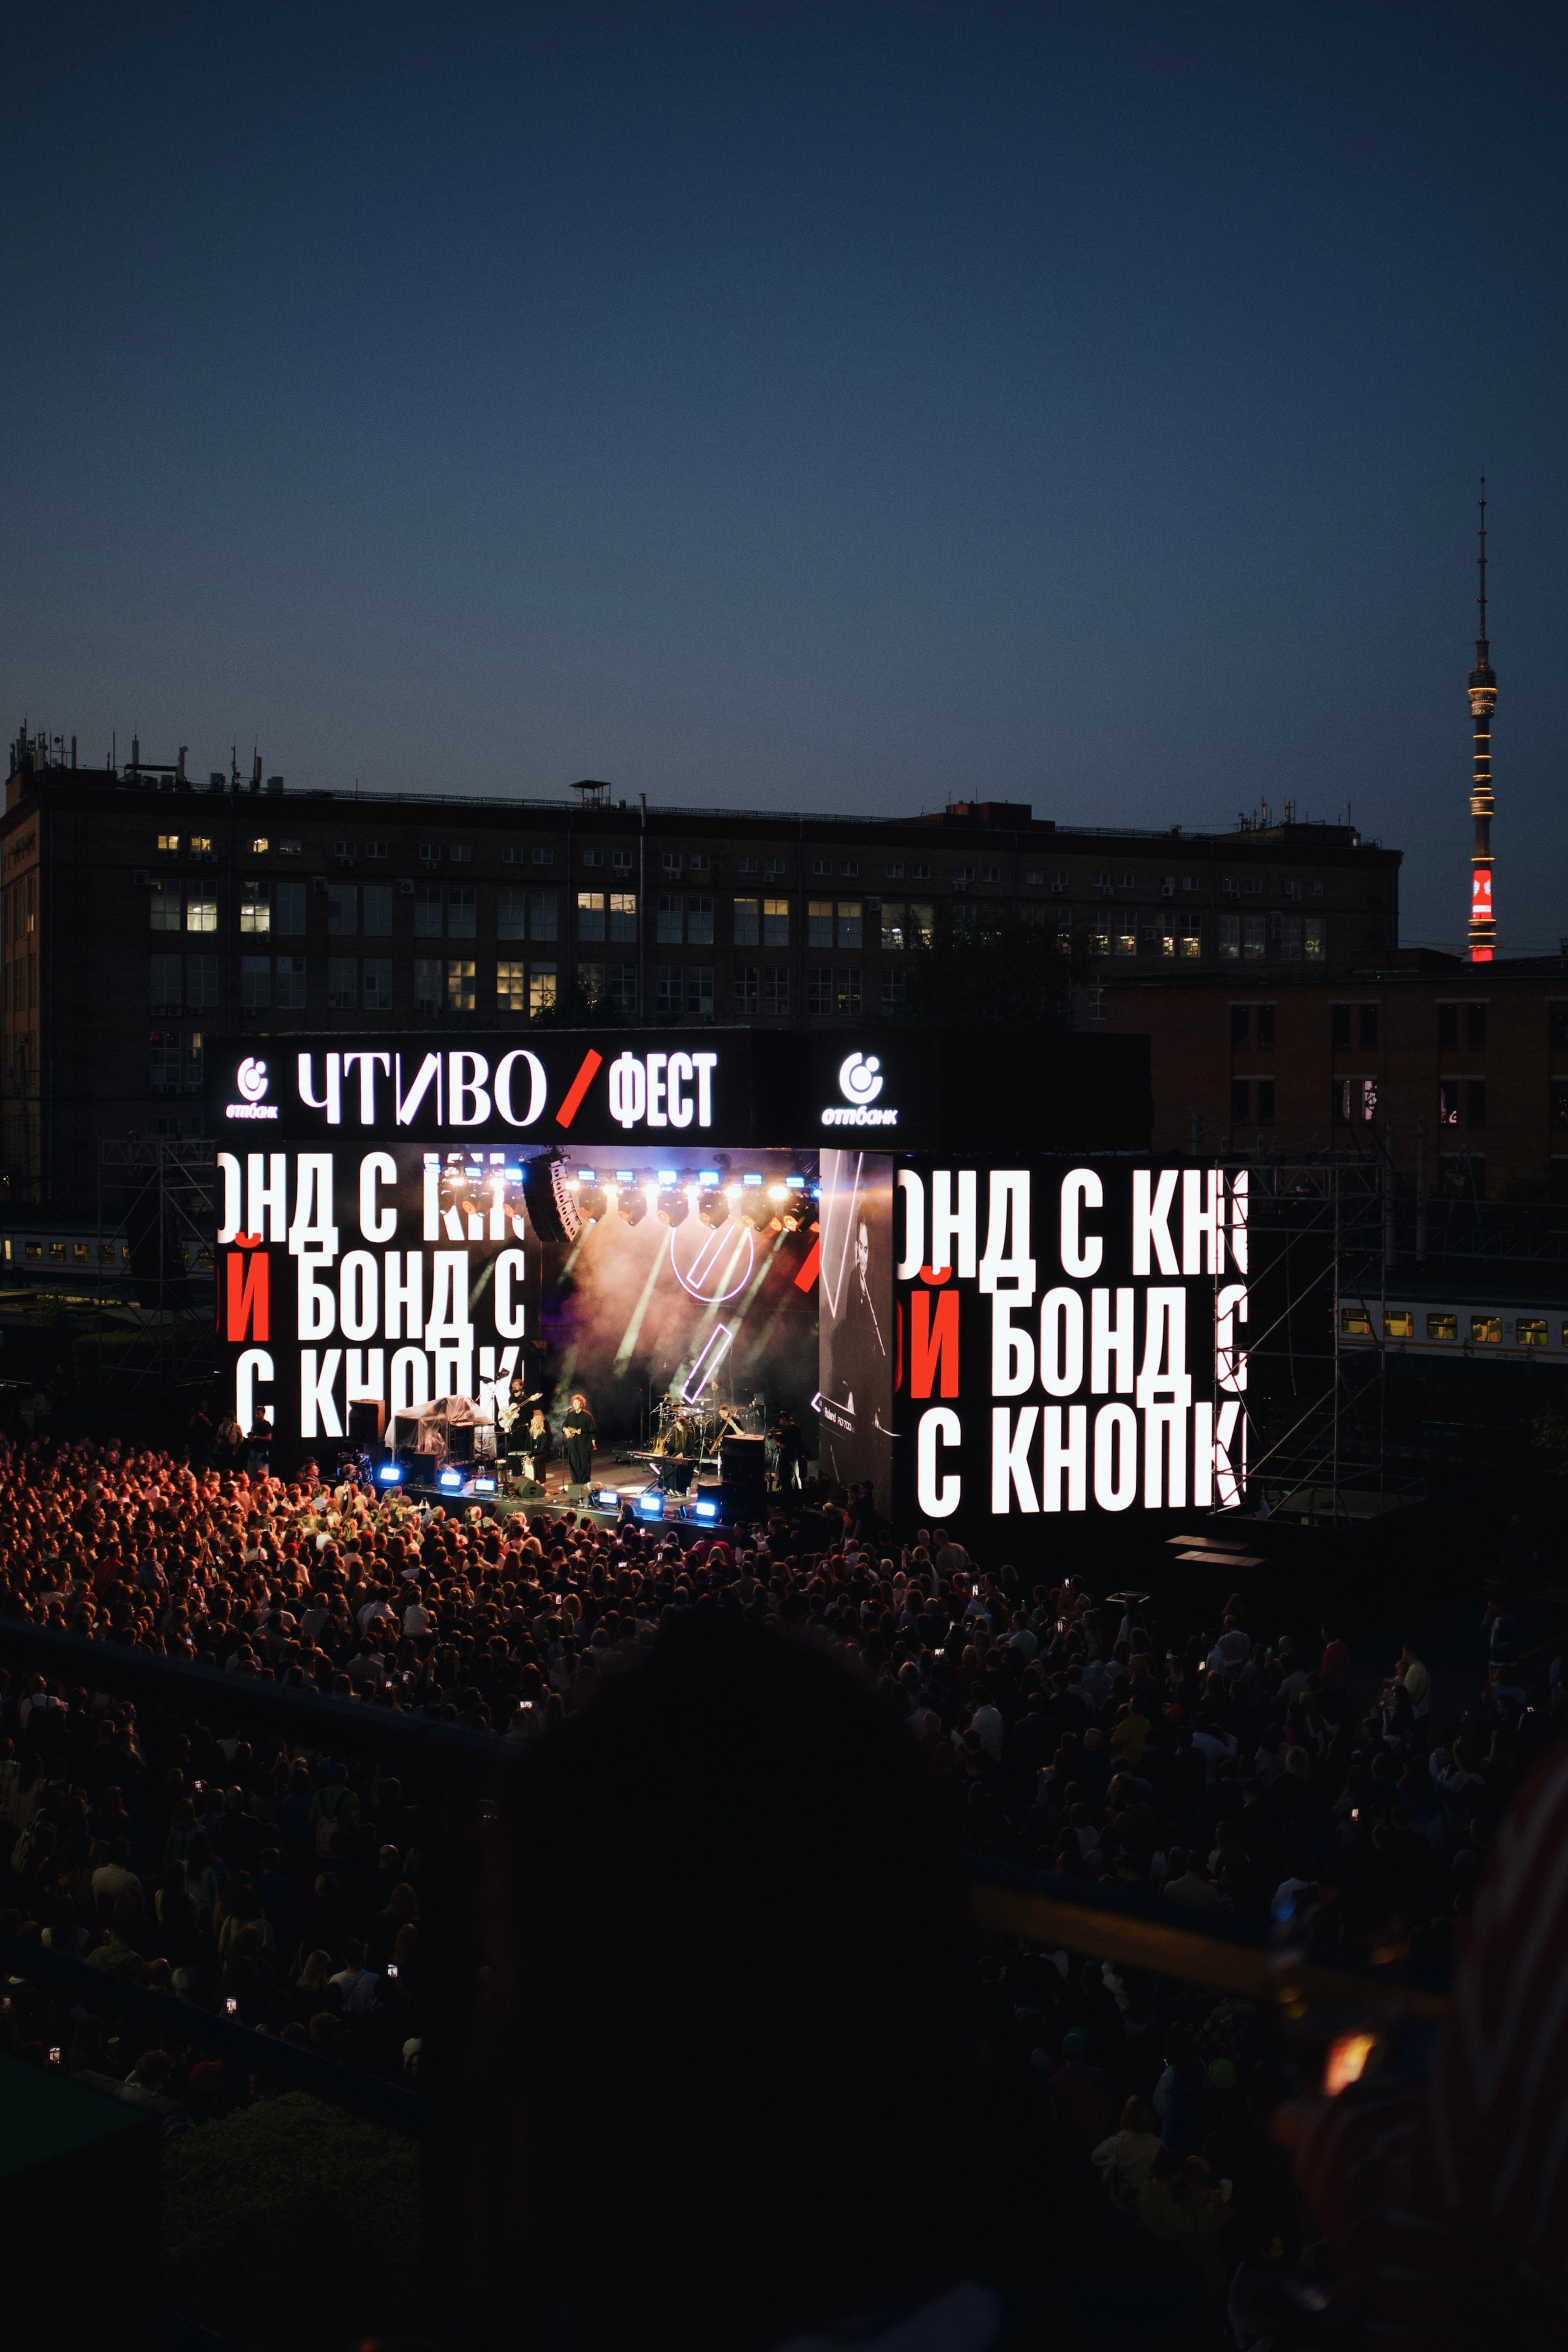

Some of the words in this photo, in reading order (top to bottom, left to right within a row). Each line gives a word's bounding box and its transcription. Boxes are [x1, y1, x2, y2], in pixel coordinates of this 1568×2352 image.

[298, 1050, 547, 1126] ЧТИВО
[609, 1051, 717, 1129] ФЕСТ
[359, 1152, 398, 1243] С
[1060, 1168, 1103, 1278] С
[216, 1232, 269, 1342] Й
[298, 1250, 474, 1351] БОНД
[494, 1248, 525, 1339] С
[894, 1265, 959, 1399] Й
[991, 1286, 1192, 1408] БОНД
[236, 1349, 274, 1439] С
[301, 1346, 524, 1438] КНОПК
[918, 1407, 961, 1518] С
[992, 1401, 1247, 1514] КНОПК
